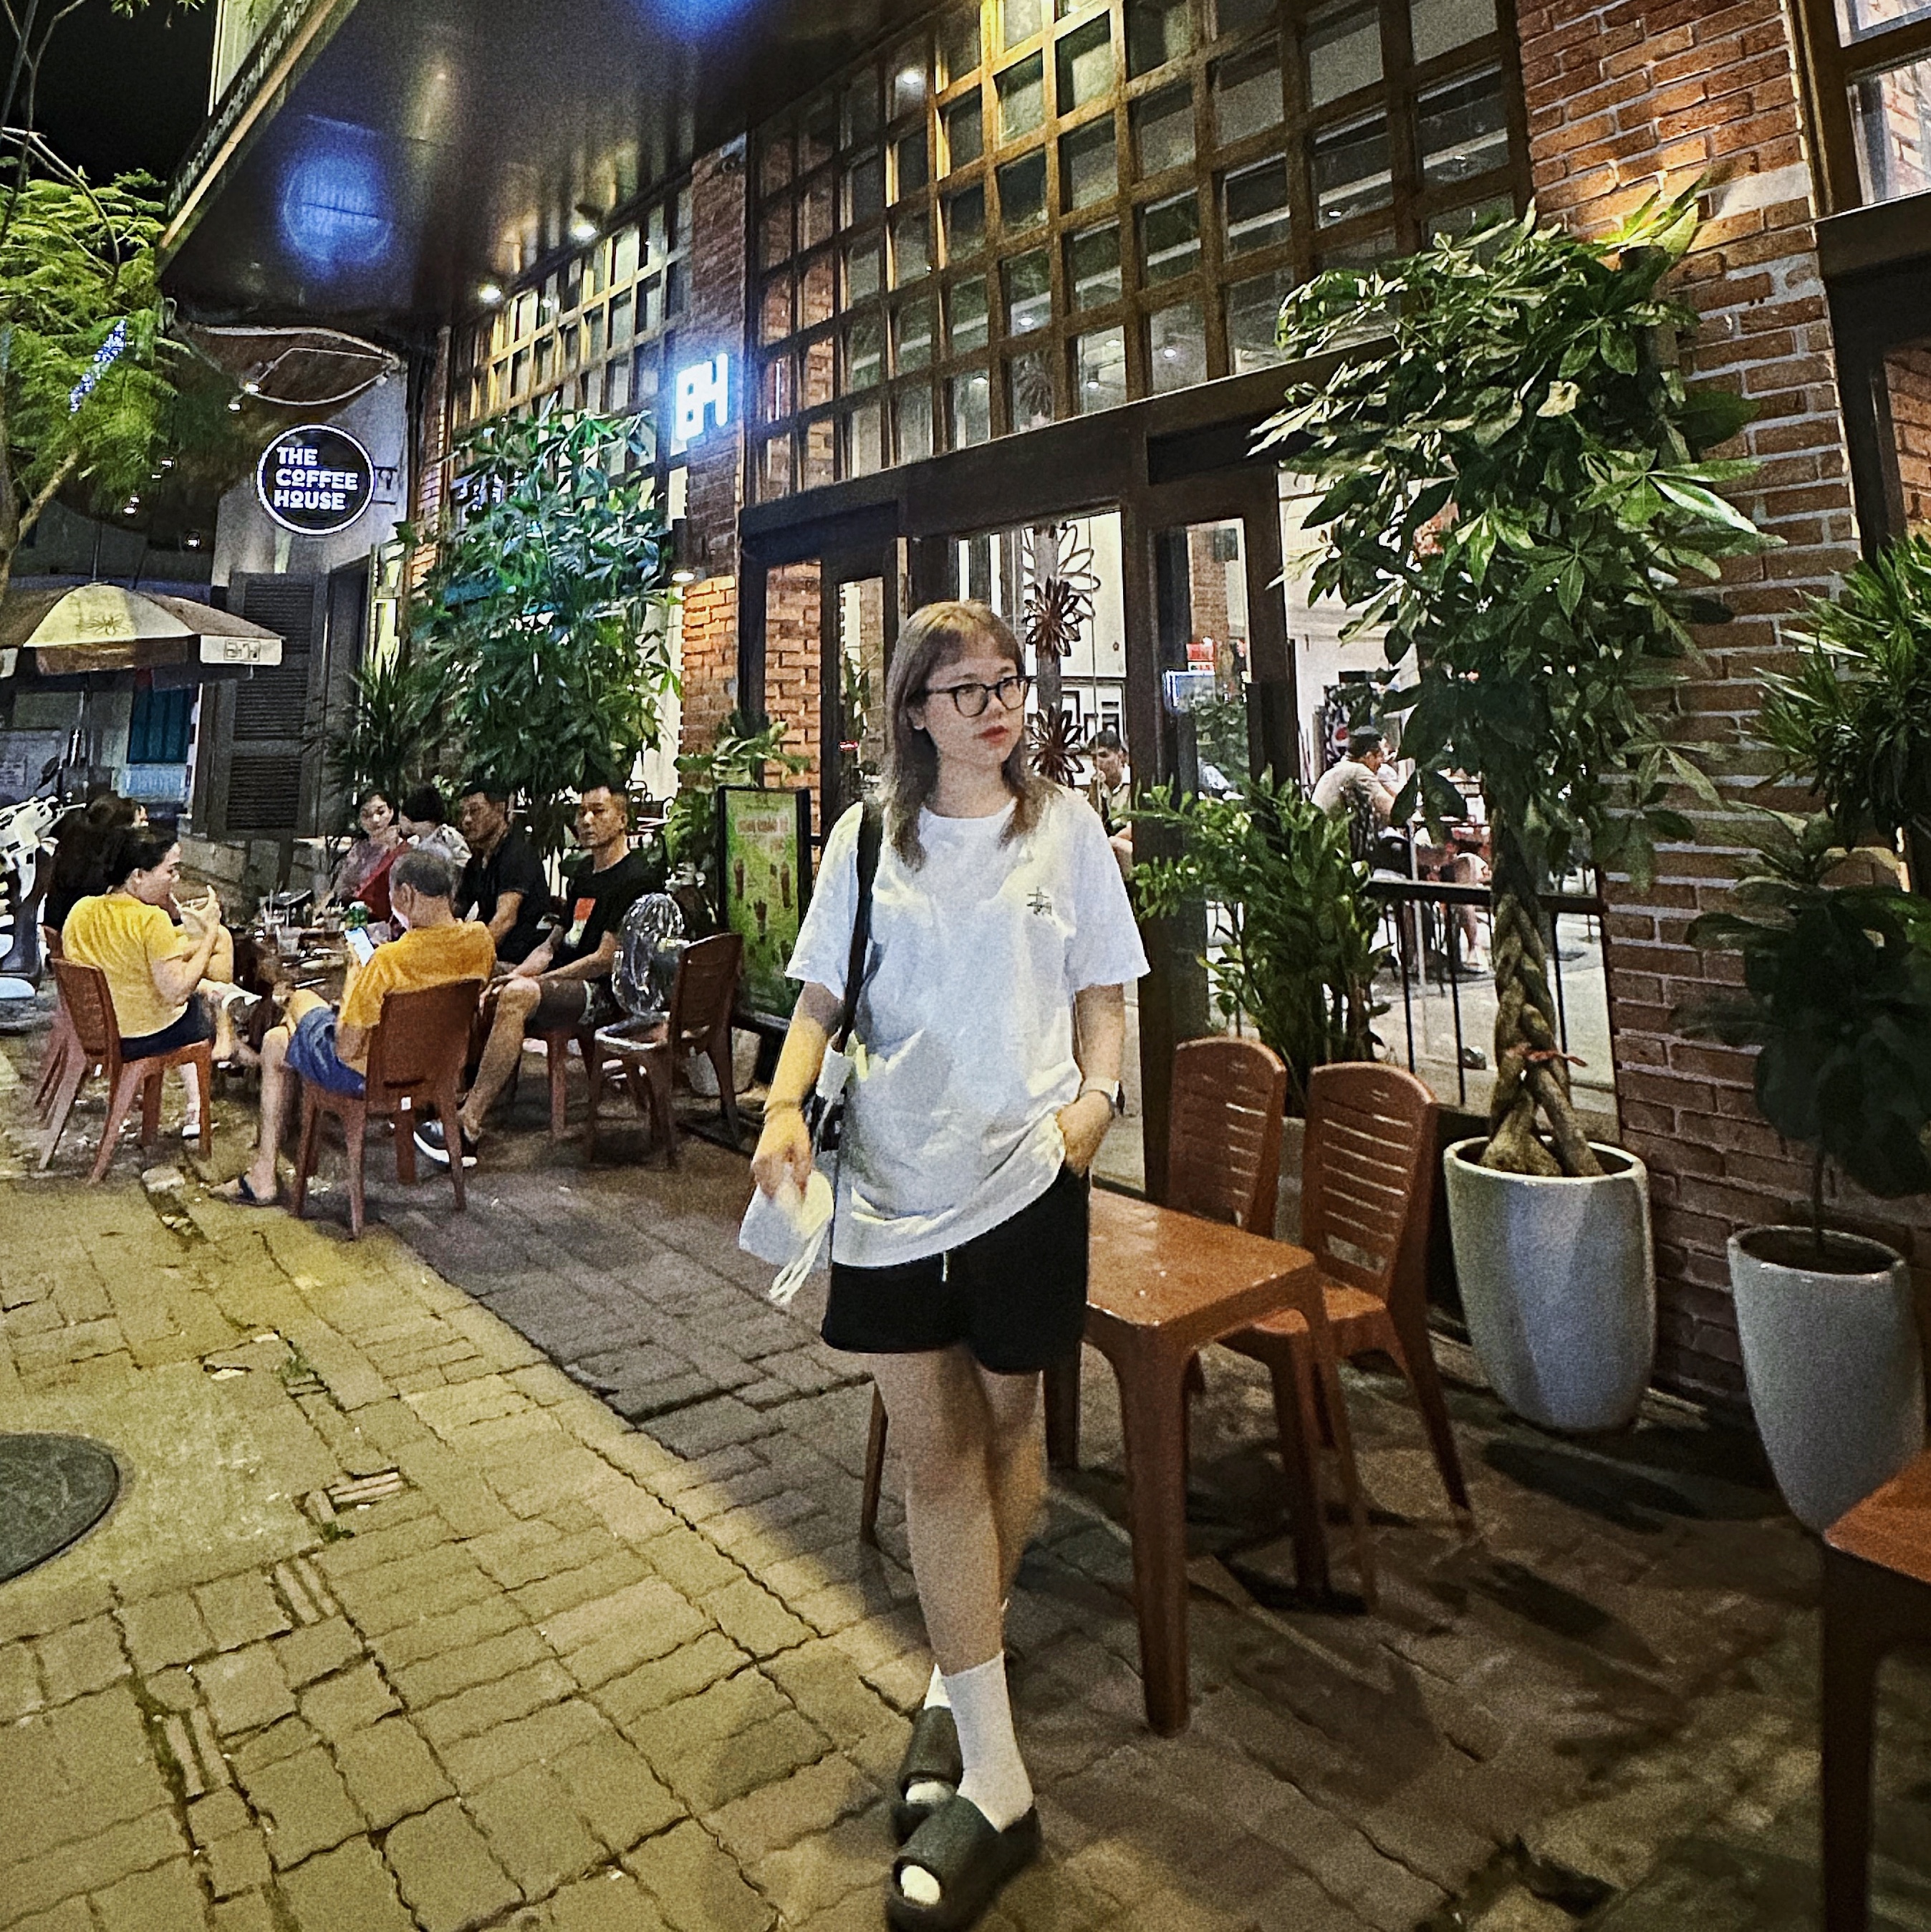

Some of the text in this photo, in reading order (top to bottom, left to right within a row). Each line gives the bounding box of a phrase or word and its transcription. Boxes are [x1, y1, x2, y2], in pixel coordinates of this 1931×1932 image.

[276, 446, 318, 466] THE
[275, 468, 359, 491] COFFEE
[273, 489, 347, 511] HOUSE
